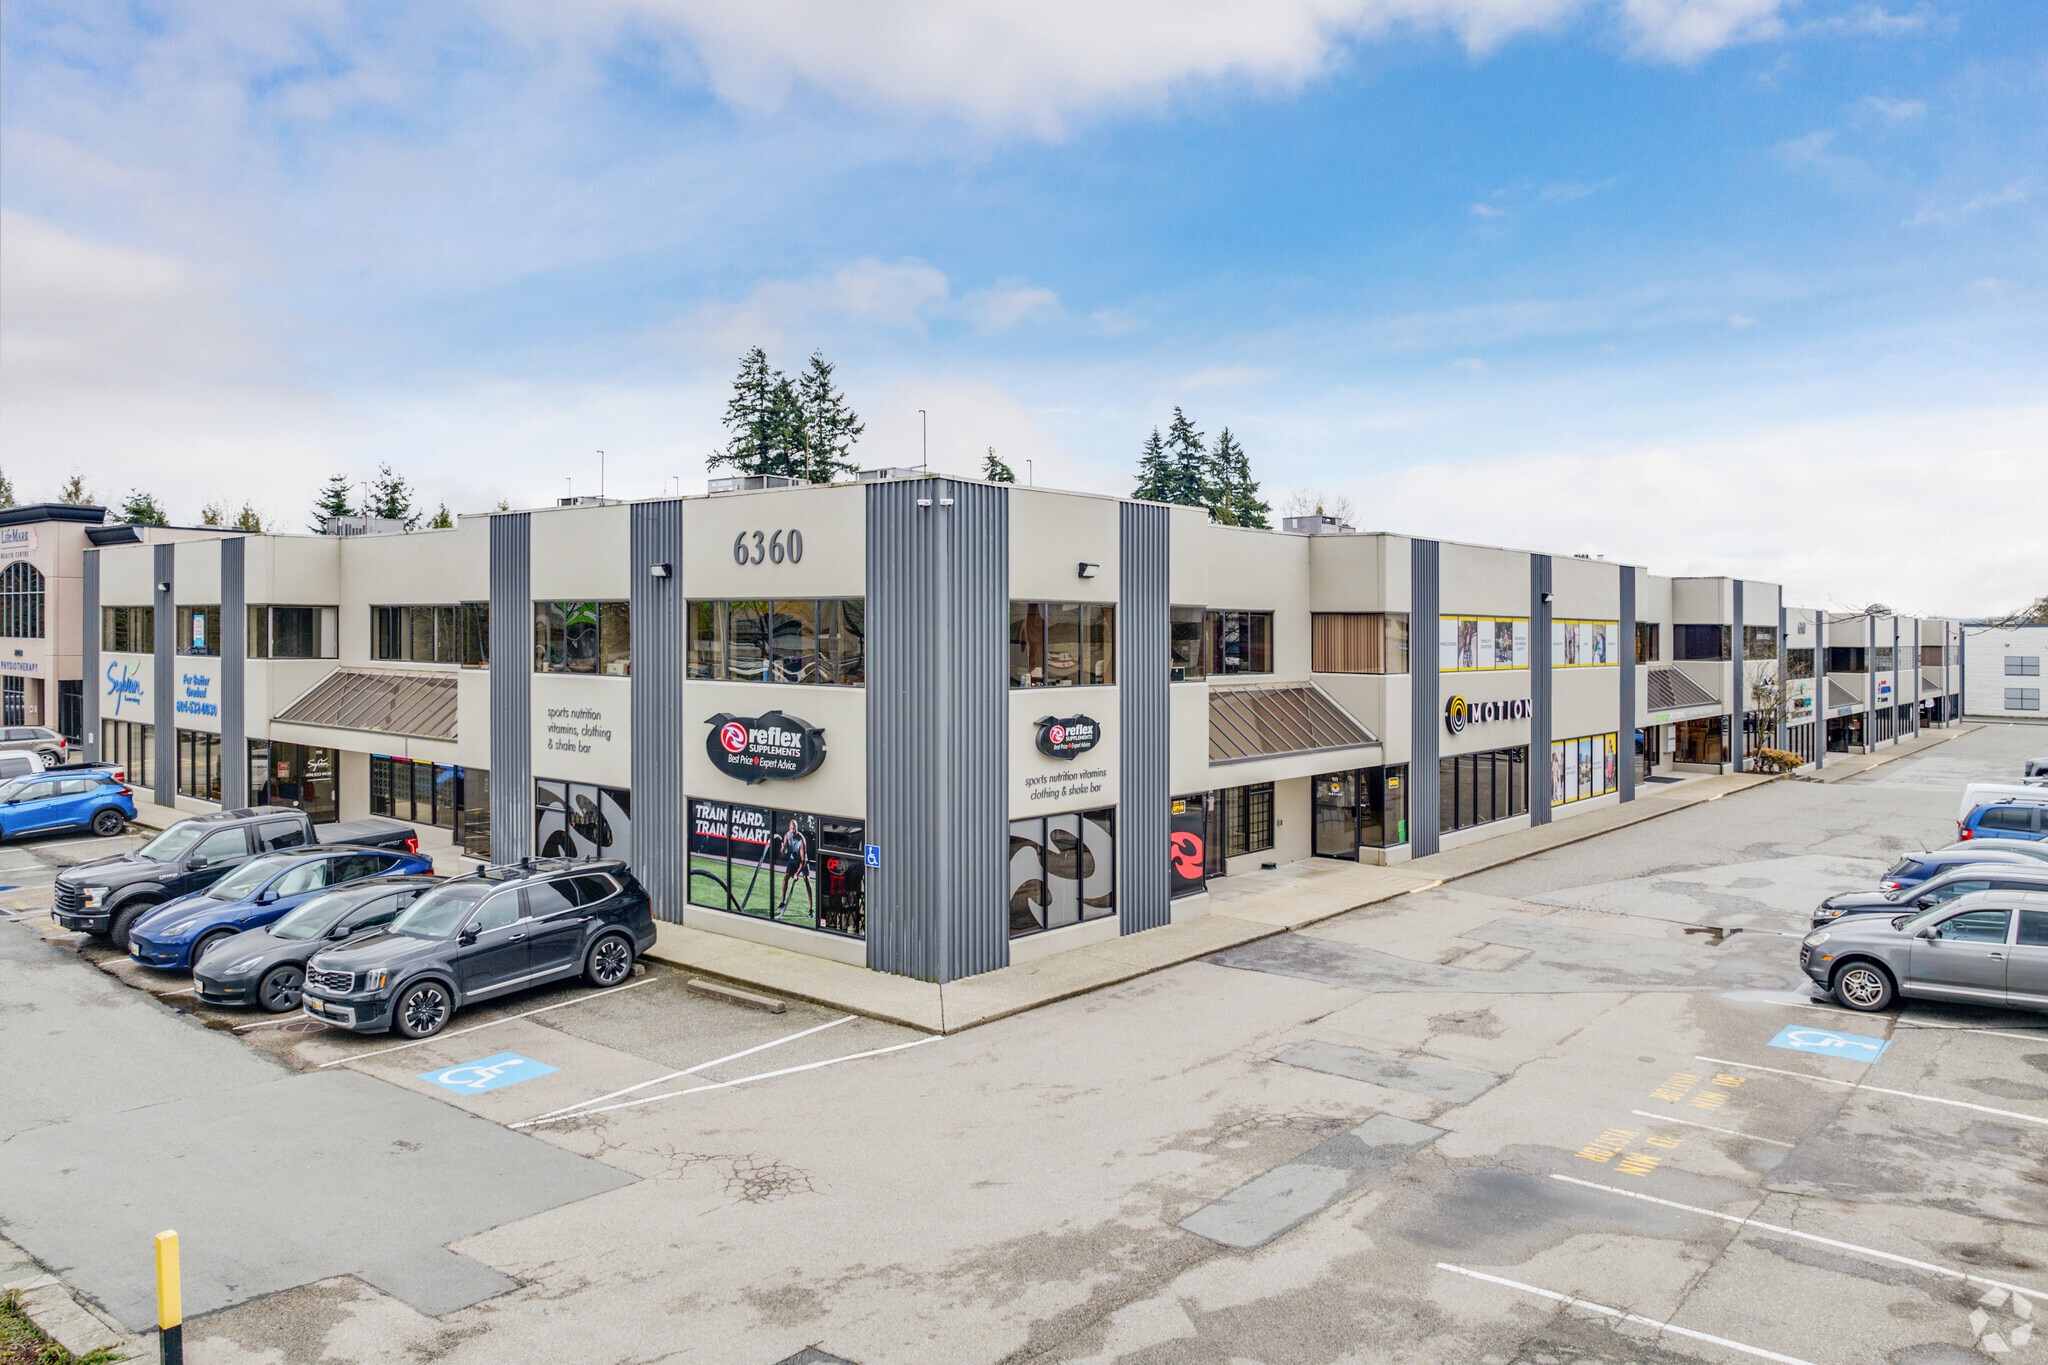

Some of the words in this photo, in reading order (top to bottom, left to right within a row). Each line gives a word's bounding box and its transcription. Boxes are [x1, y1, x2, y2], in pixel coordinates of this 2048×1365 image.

[733, 528, 803, 565] 6360
[547, 707, 569, 719] sports
[571, 708, 601, 720] nutrition
[1468, 698, 1532, 723] MOTION
[548, 722, 579, 737] vitamins,
[581, 724, 611, 741] clothing
[749, 727, 802, 748] reflex
[1065, 724, 1094, 736] reflex
[547, 738, 553, 750] &
[555, 738, 577, 752] shake
[578, 740, 591, 753] bar
[749, 744, 801, 757] SUPPLEMENTS
[728, 754, 739, 763] Best
[740, 756, 753, 766] Price
[760, 758, 777, 769] Expert
[777, 760, 797, 770] Advice
[1025, 775, 1048, 788] sports
[1049, 770, 1078, 783] nutrition
[1080, 768, 1107, 780] vitamins
[1030, 787, 1060, 800] clothing
[1061, 786, 1067, 796] &
[1069, 783, 1088, 795] shake
[1090, 782, 1102, 793] bar
[696, 805, 728, 821] TRAIN
[732, 809, 765, 827] HARD.
[696, 820, 728, 836] TRAIN
[731, 825, 771, 844] SMART.
